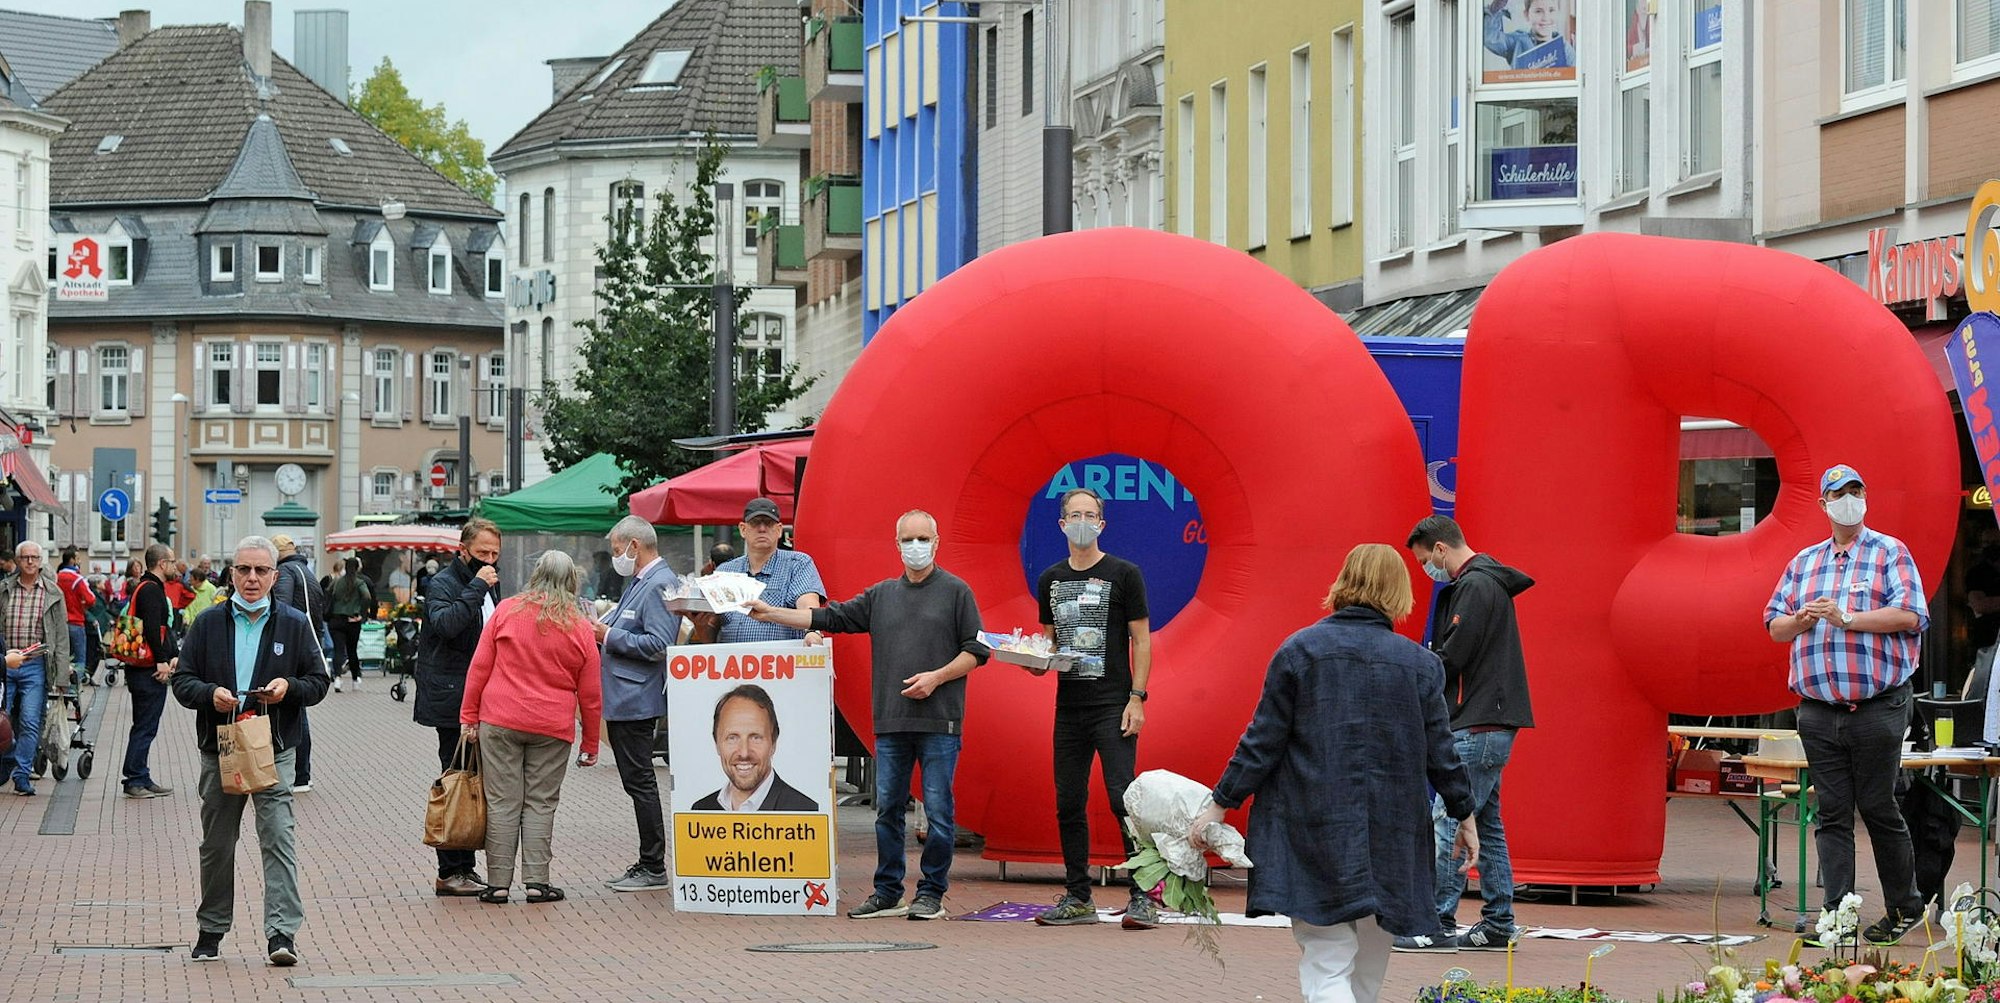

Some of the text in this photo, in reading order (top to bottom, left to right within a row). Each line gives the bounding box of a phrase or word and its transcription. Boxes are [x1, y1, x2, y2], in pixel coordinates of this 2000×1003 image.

[64, 281, 102, 289] Altstadt
[1868, 228, 1959, 321] Kamps
[61, 289, 104, 297] Apotheke
[1046, 458, 1194, 512] AREN
[669, 655, 826, 680] OPLADEN PLUS
[688, 822, 815, 841] Uwe Richrath
[705, 851, 794, 873] wählen!
[679, 883, 800, 908] 13. September
